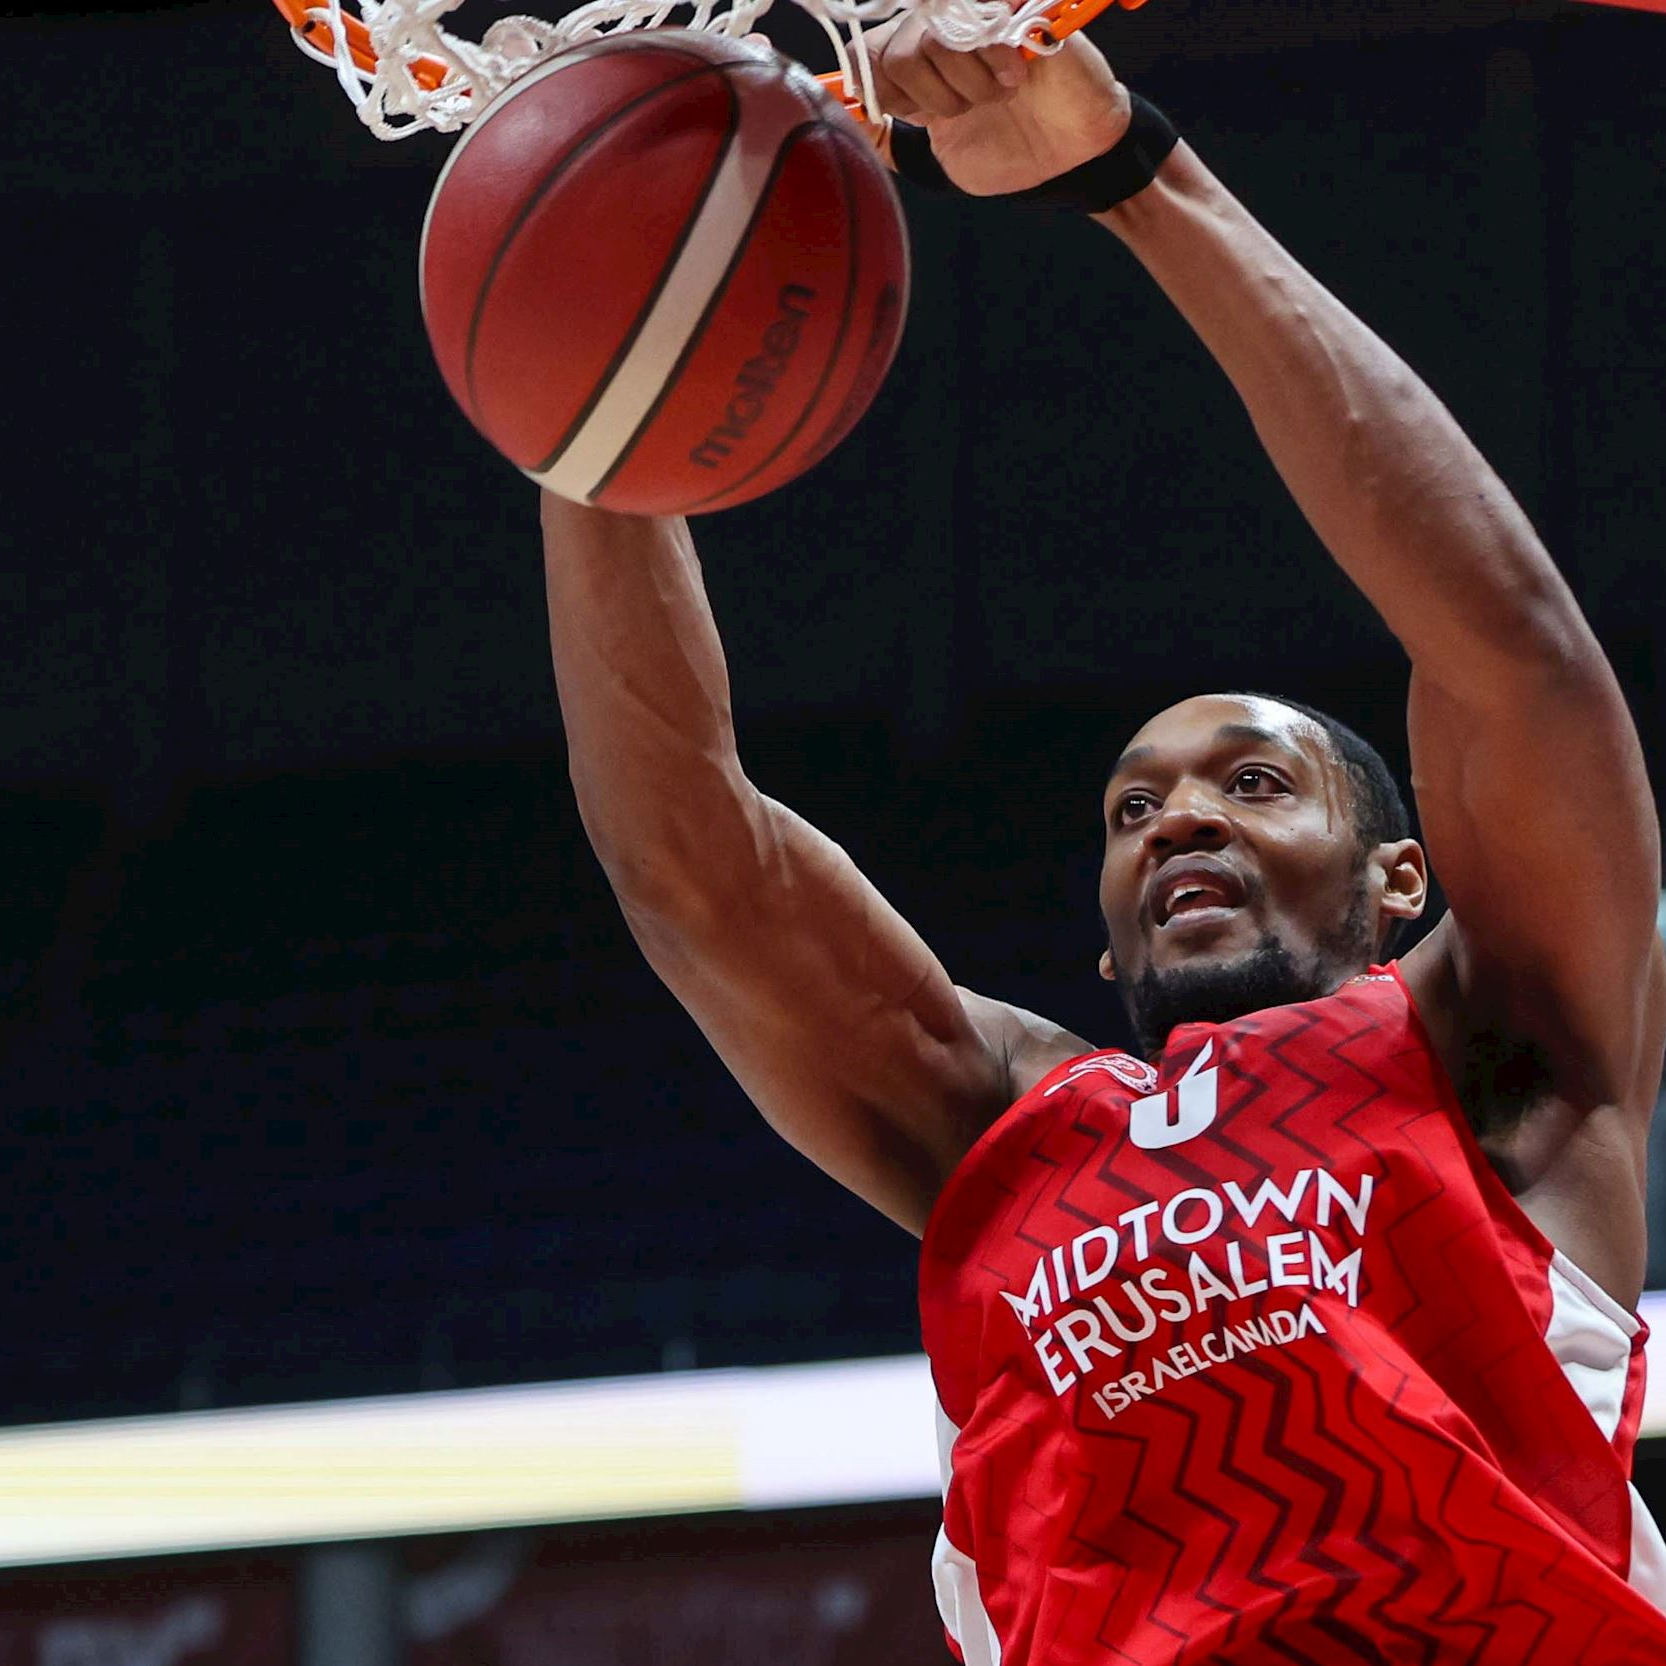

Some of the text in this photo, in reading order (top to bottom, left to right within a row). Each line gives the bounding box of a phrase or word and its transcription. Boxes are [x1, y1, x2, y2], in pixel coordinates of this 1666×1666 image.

[689, 283, 817, 469] molten
[998, 1167, 1375, 1342] MIDTOWN
[1033, 1229, 1363, 1398] ERUSALEM
